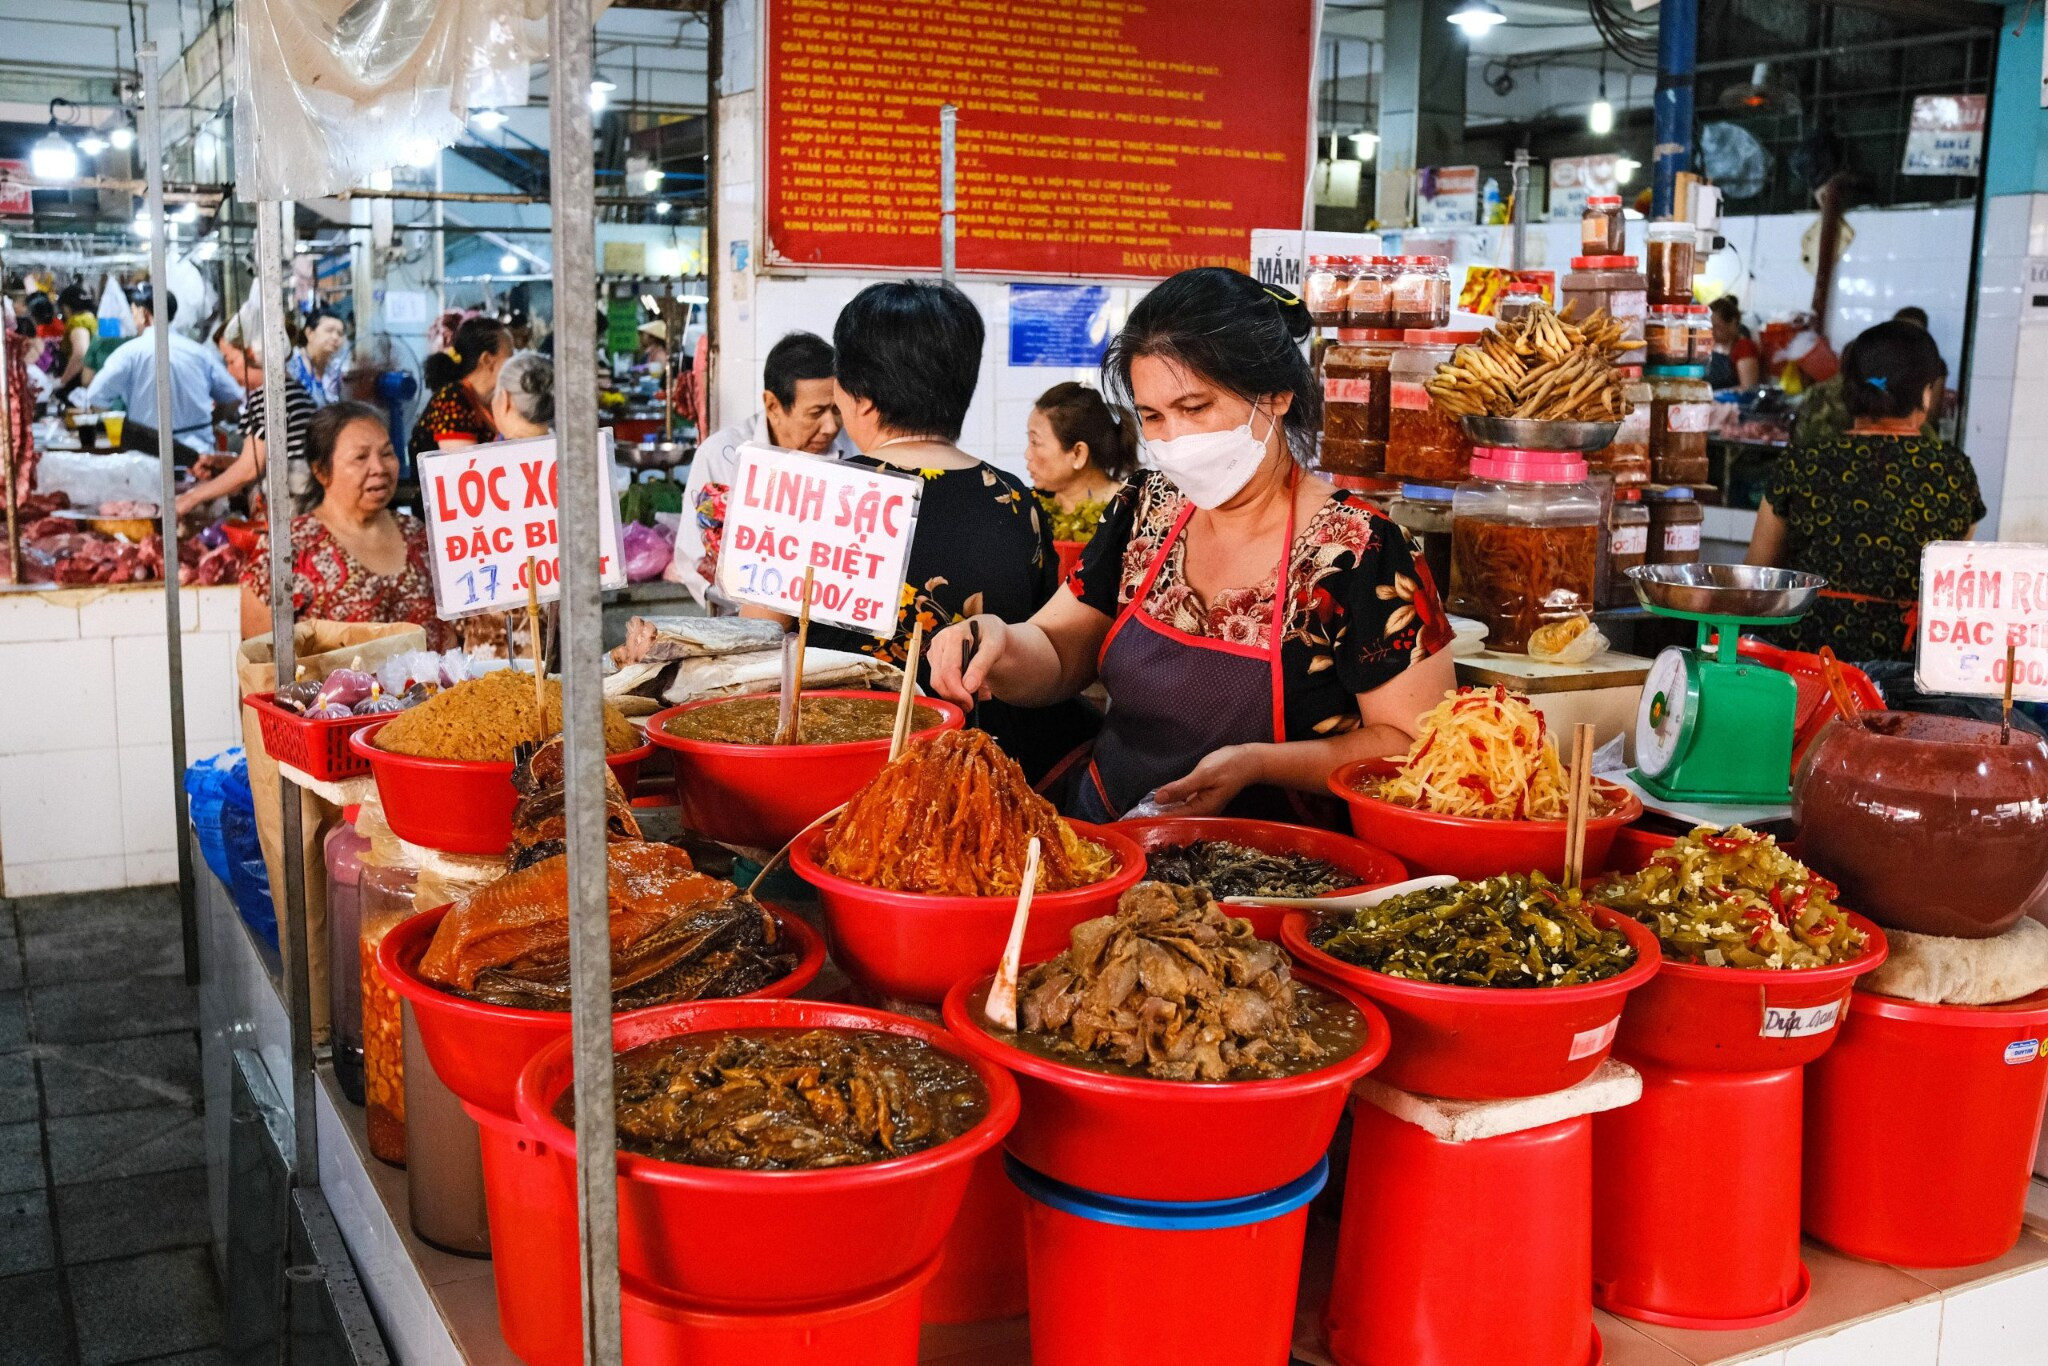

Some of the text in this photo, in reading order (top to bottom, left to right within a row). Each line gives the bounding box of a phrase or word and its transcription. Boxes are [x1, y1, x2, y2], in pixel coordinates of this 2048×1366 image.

[1257, 246, 1299, 285] MẮM
[435, 459, 510, 522] LÓC
[744, 464, 904, 543] LINH SẶC
[446, 519, 559, 563] ĐẶC BI
[735, 525, 885, 580] ĐẶC BIỆT
[1932, 554, 2001, 612] MẮM
[1928, 615, 1994, 651] ĐẶC
